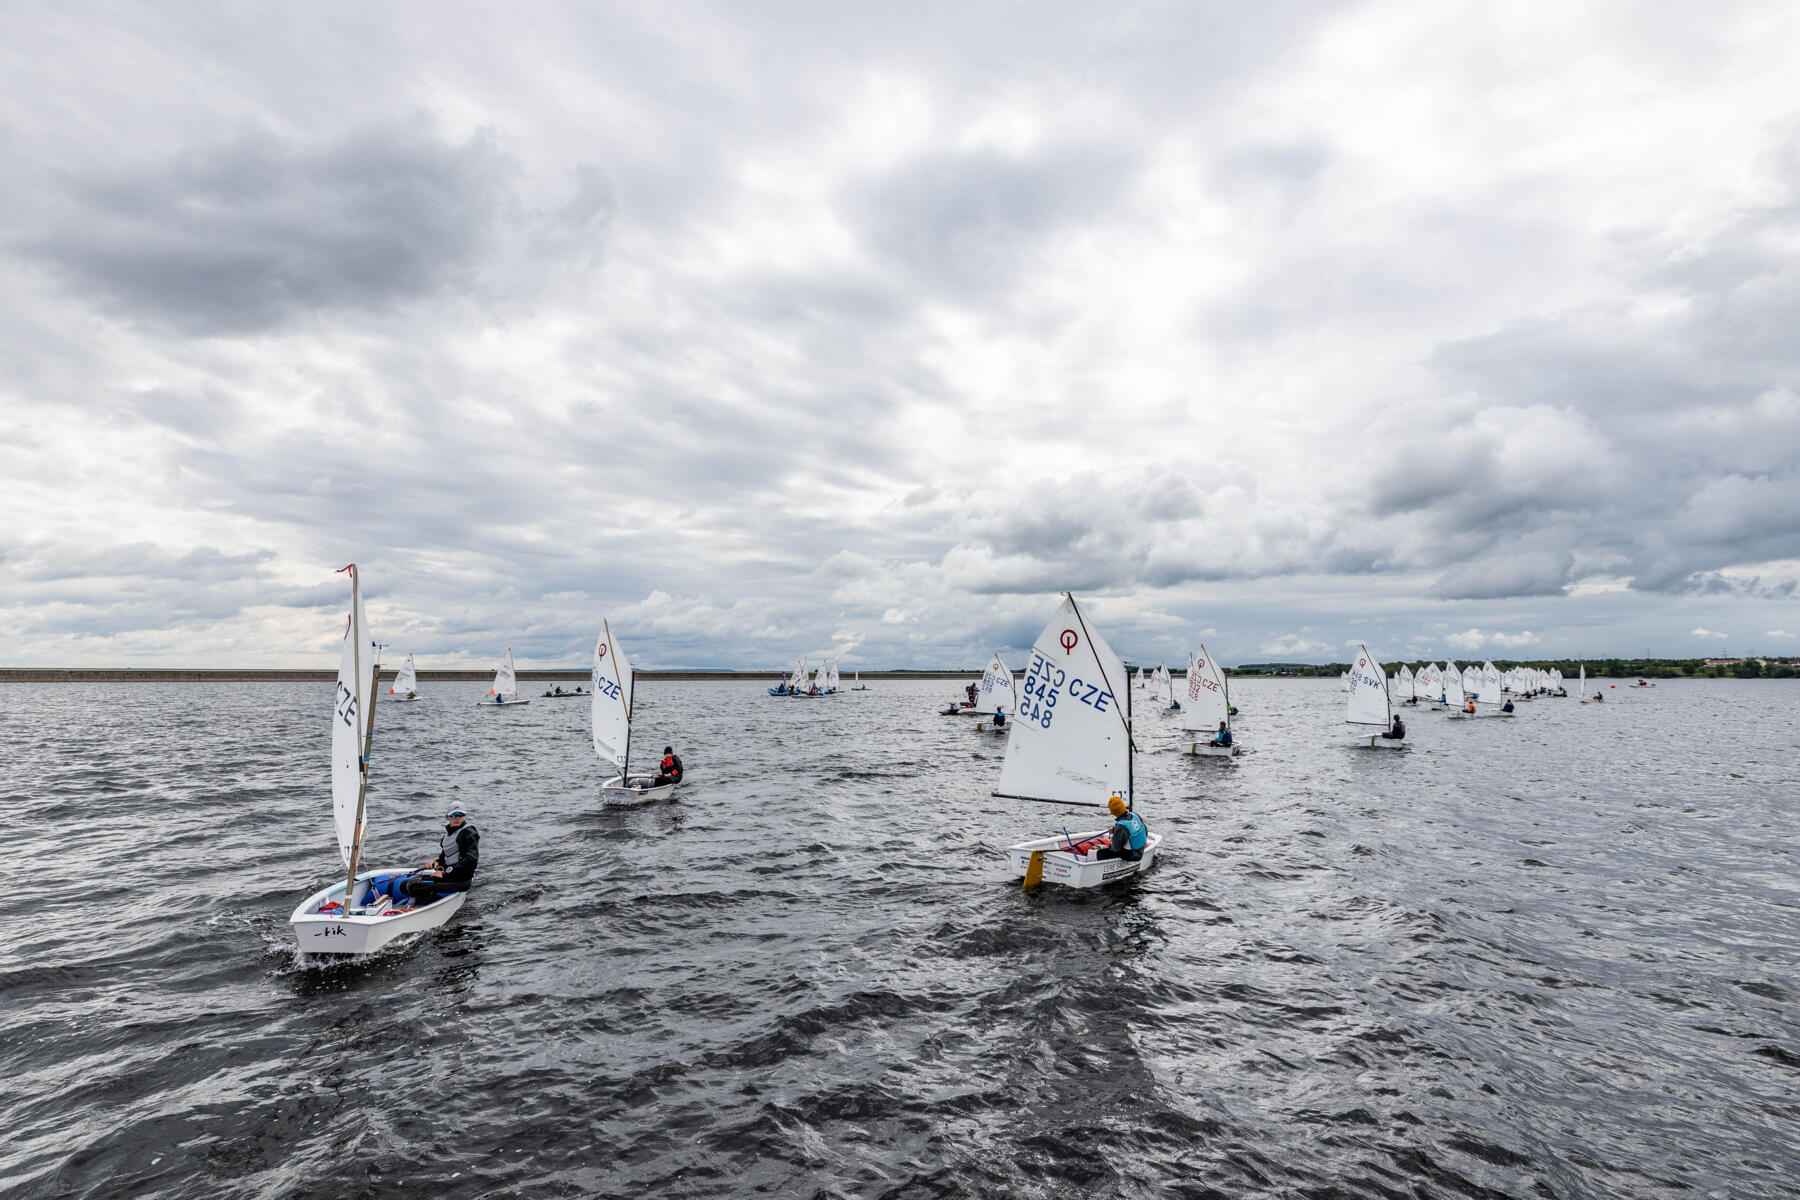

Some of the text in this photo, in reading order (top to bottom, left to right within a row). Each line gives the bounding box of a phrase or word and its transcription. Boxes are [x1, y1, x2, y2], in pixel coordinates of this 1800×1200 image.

[599, 676, 621, 701] CZE
[996, 677, 1009, 688] CZE
[1024, 675, 1060, 708] 845
[1202, 678, 1220, 692] CZE
[1363, 676, 1380, 690] SVK
[335, 680, 357, 727] CZE
[1069, 678, 1113, 713] CZE
